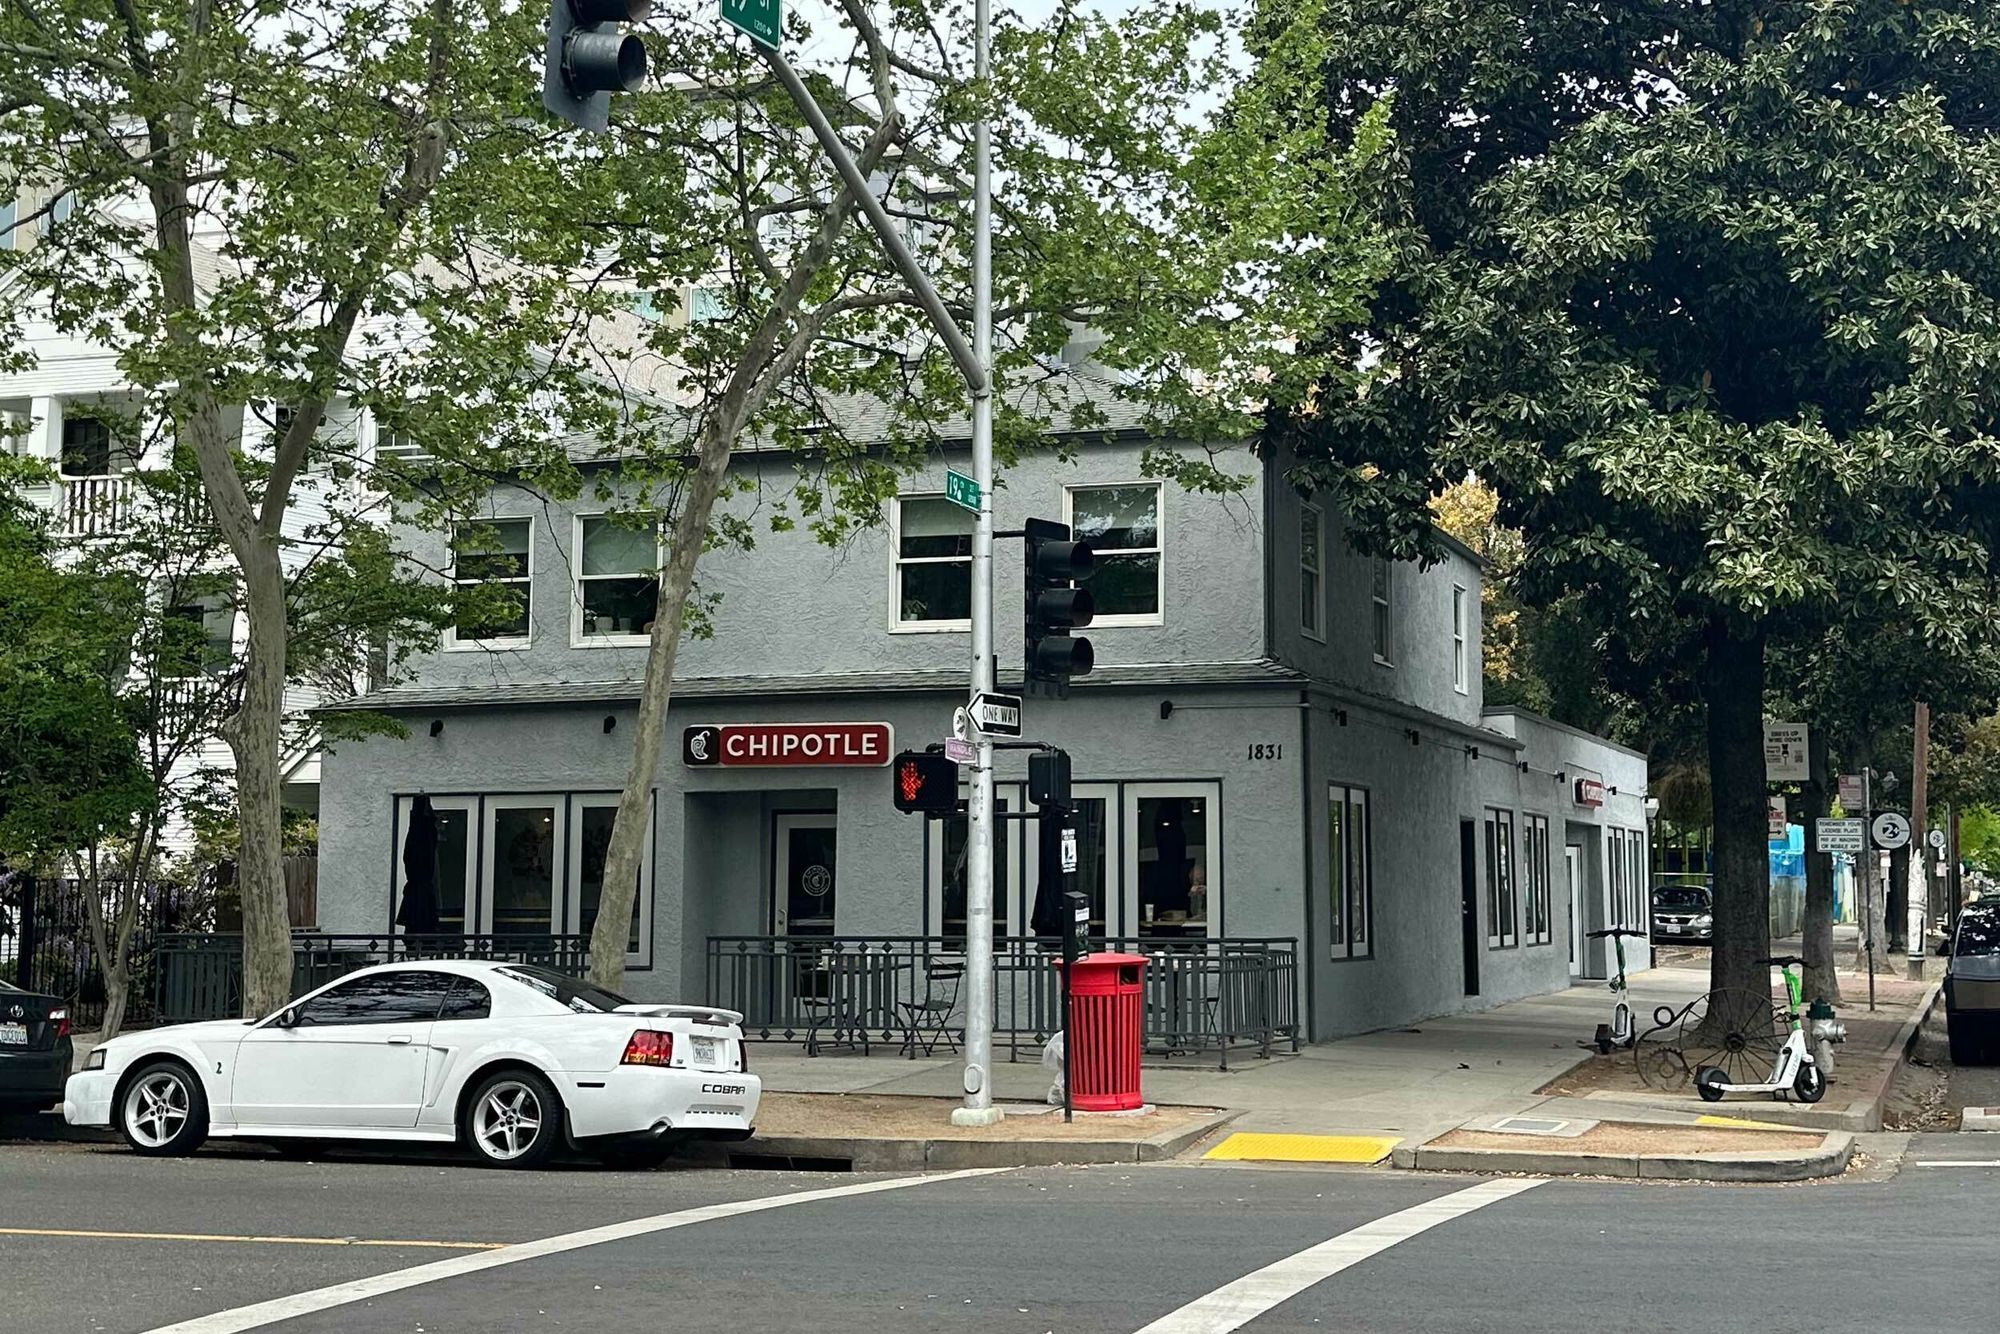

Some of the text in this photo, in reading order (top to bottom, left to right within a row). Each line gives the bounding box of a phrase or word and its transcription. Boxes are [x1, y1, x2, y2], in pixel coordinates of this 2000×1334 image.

[949, 475, 958, 496] 19
[982, 705, 1017, 724] ONE WAY
[726, 733, 878, 757] CHIPOTLE
[1248, 743, 1282, 760] 1831
[701, 1083, 746, 1095] COBRA
